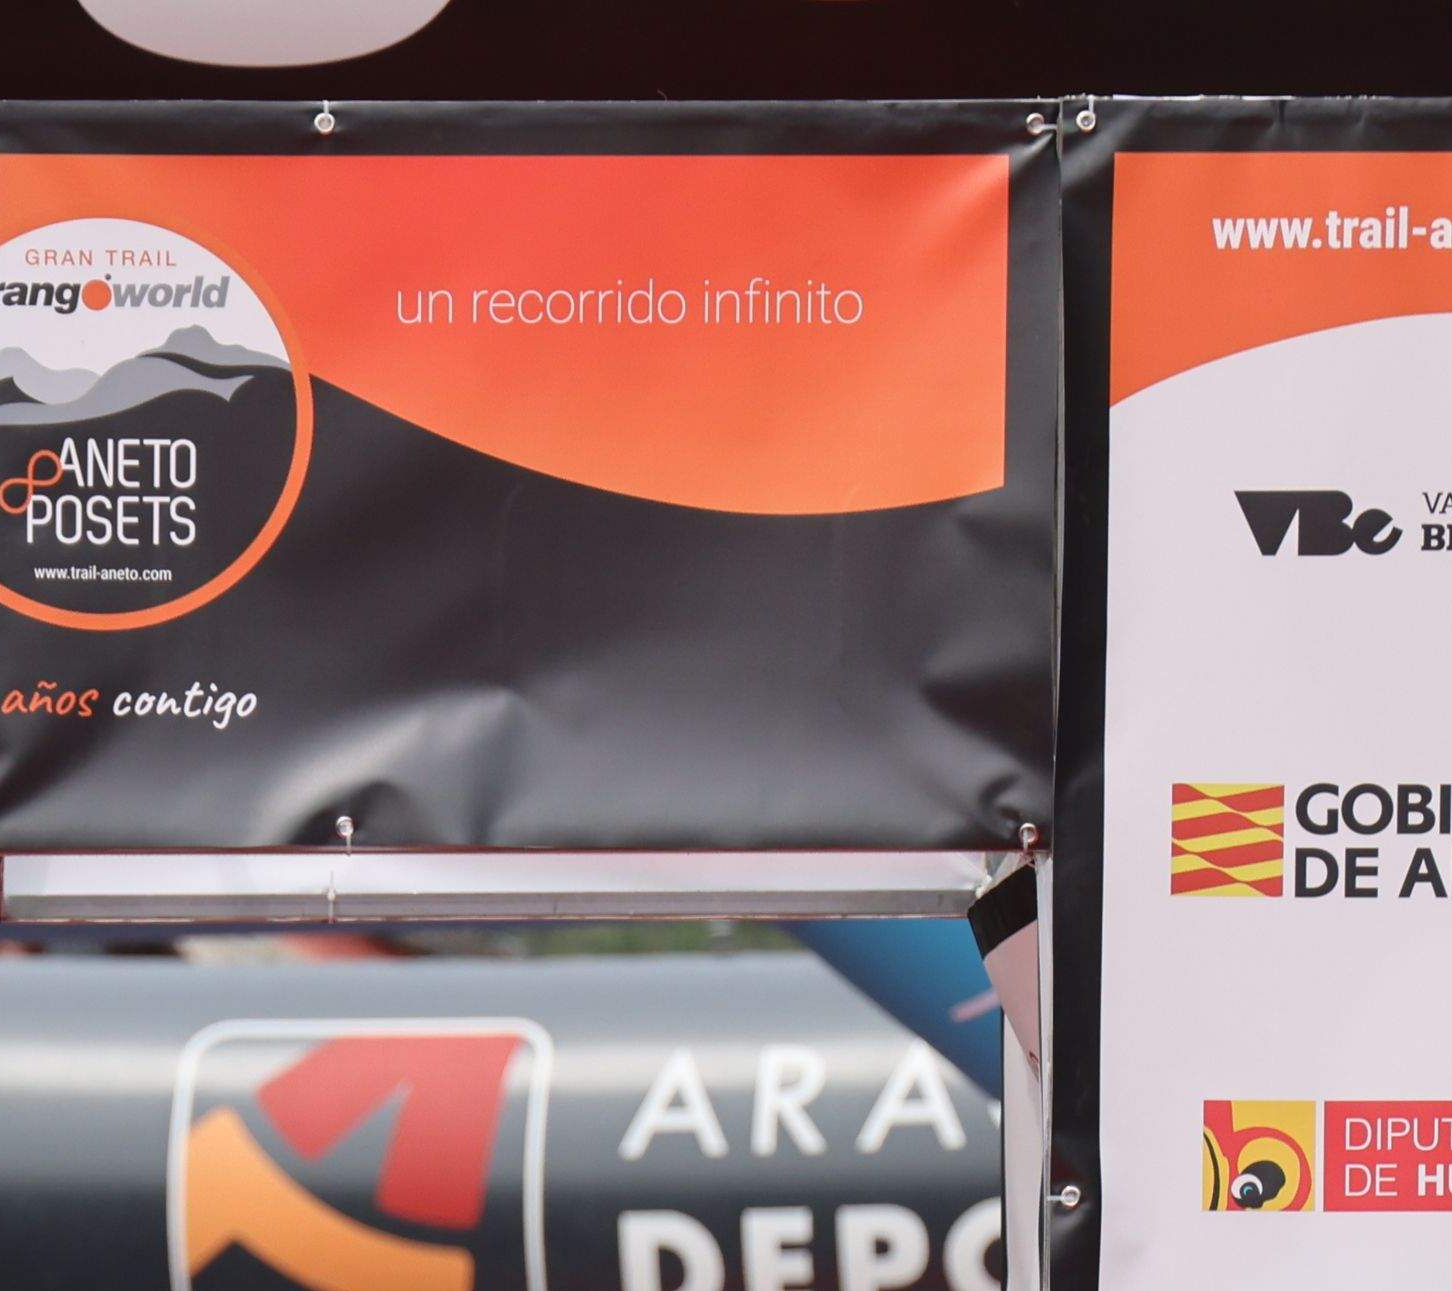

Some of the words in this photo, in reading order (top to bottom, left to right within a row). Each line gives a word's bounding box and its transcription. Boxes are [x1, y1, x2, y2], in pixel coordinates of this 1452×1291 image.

[25, 249, 93, 266] GRAN
[106, 250, 177, 267] TRAIL
[397, 287, 453, 324] un
[472, 279, 687, 324] recorrido
[703, 277, 864, 324] infinito
[59, 438, 196, 488] ANETO
[26, 495, 196, 545] POSETS
[34, 564, 173, 583] www.trail-aneto.com
[1, 681, 100, 718] años
[112, 681, 258, 729] contigo
[1295, 847, 1379, 899] DE
[618, 1045, 968, 1161] ARA
[1345, 1164, 1399, 1197] DE
